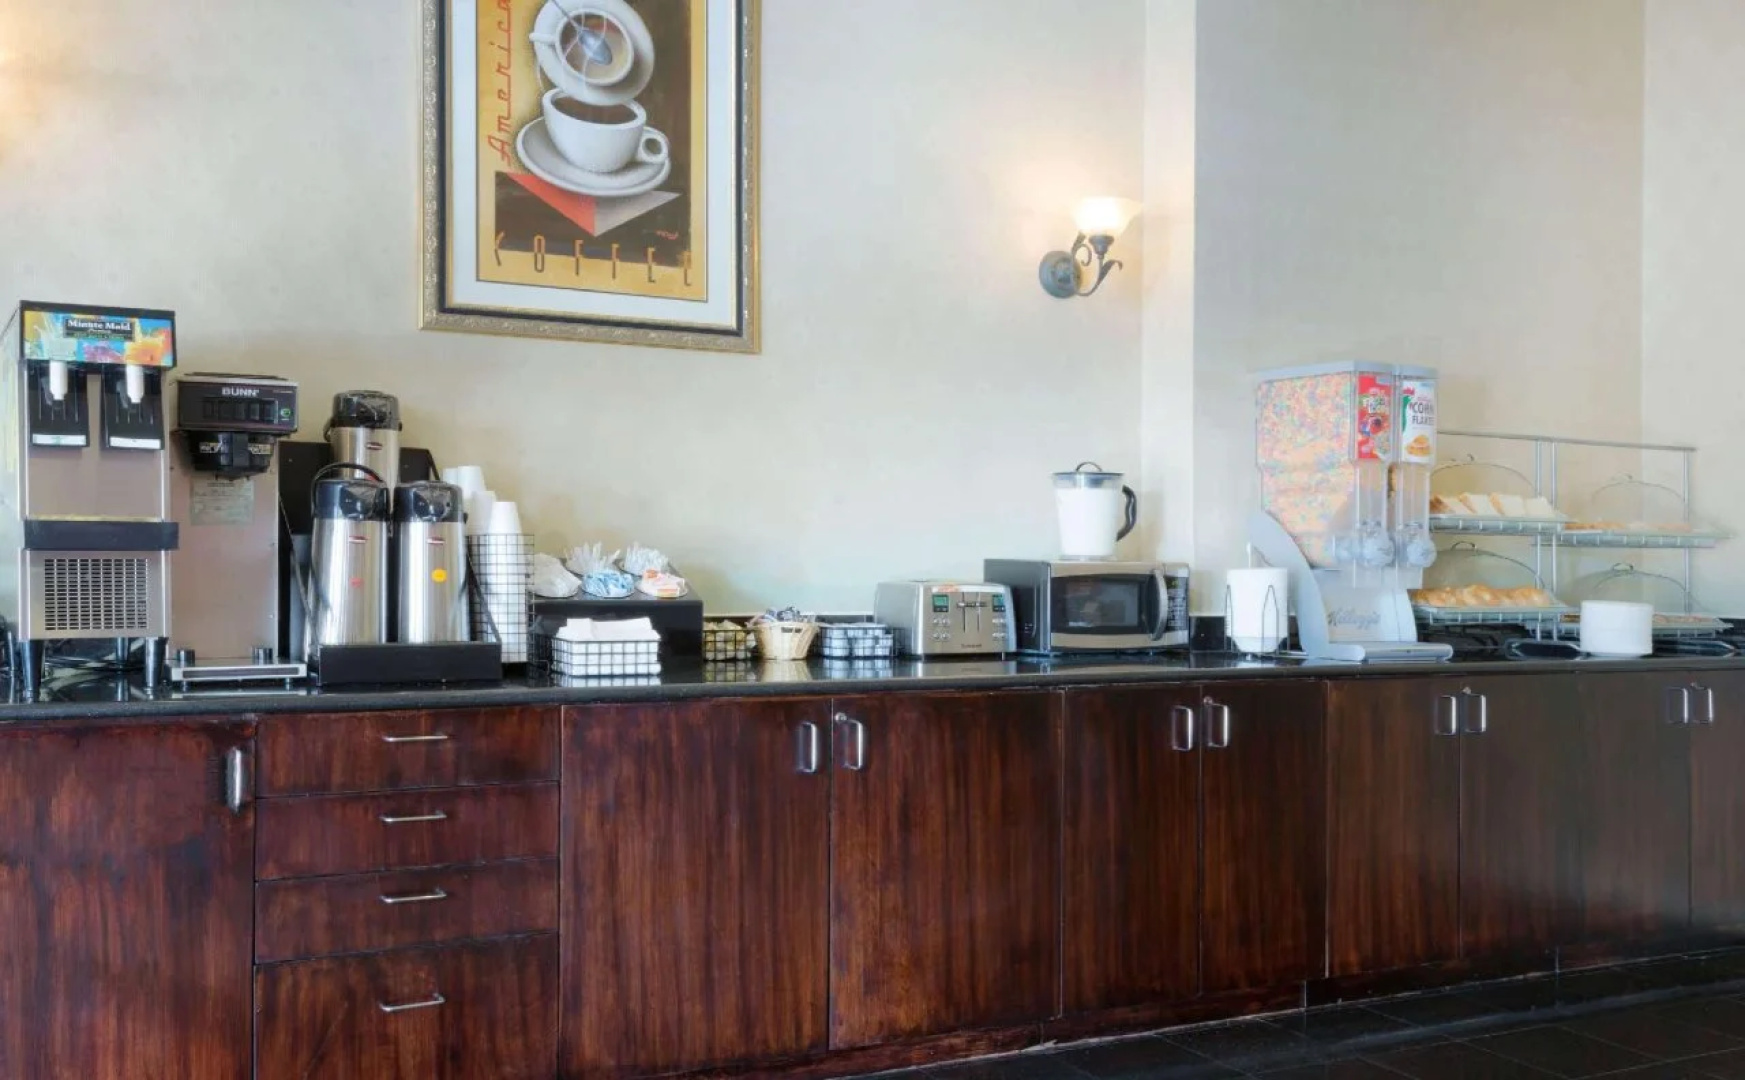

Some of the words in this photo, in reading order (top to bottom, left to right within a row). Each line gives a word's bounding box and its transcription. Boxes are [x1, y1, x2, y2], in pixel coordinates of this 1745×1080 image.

[67, 319, 104, 329] Minute
[105, 321, 132, 331] Maid
[221, 386, 257, 397] BUNN
